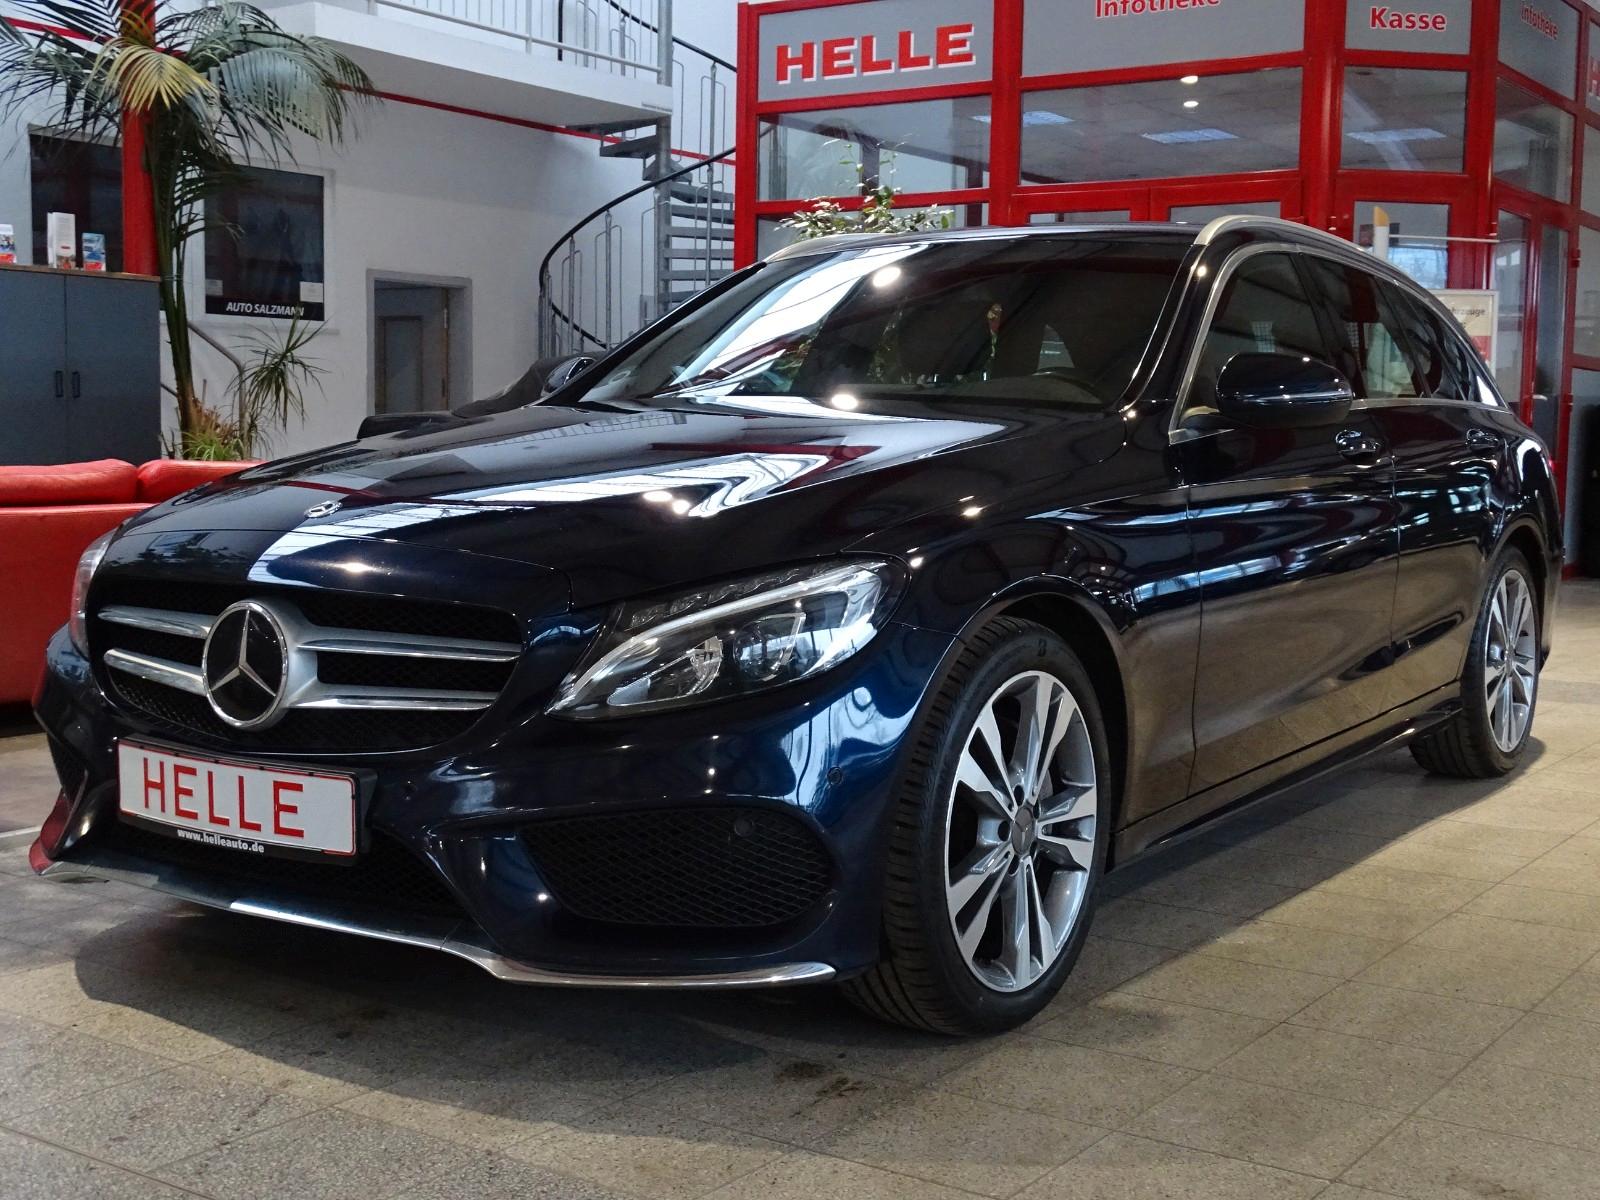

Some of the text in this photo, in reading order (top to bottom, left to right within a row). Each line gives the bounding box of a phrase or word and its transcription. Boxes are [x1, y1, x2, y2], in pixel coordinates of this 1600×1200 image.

[1370, 6, 1447, 31] Kasse
[776, 23, 976, 84] HELLE
[226, 302, 253, 314] AUTO
[143, 757, 305, 838] HELLE
[177, 828, 265, 853] www.helleauto.de
